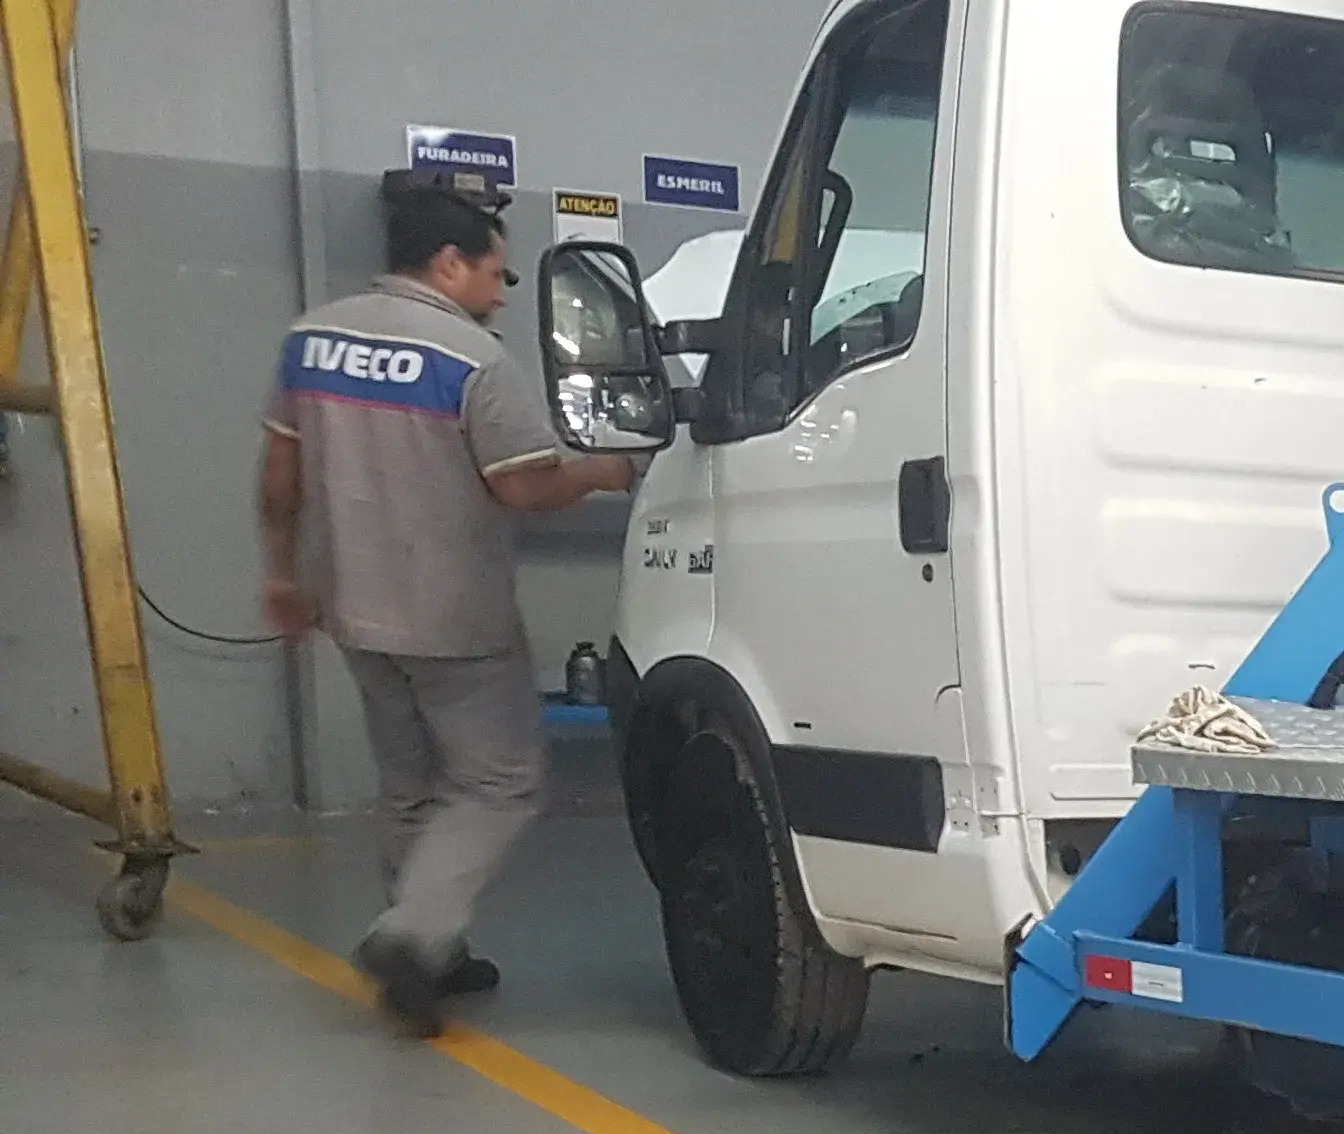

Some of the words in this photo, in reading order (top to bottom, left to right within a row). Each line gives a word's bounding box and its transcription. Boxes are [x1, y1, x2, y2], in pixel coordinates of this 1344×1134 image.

[417, 146, 509, 168] FURADEIRA
[657, 173, 724, 195] ESMERIL
[301, 336, 424, 384] IVECO
